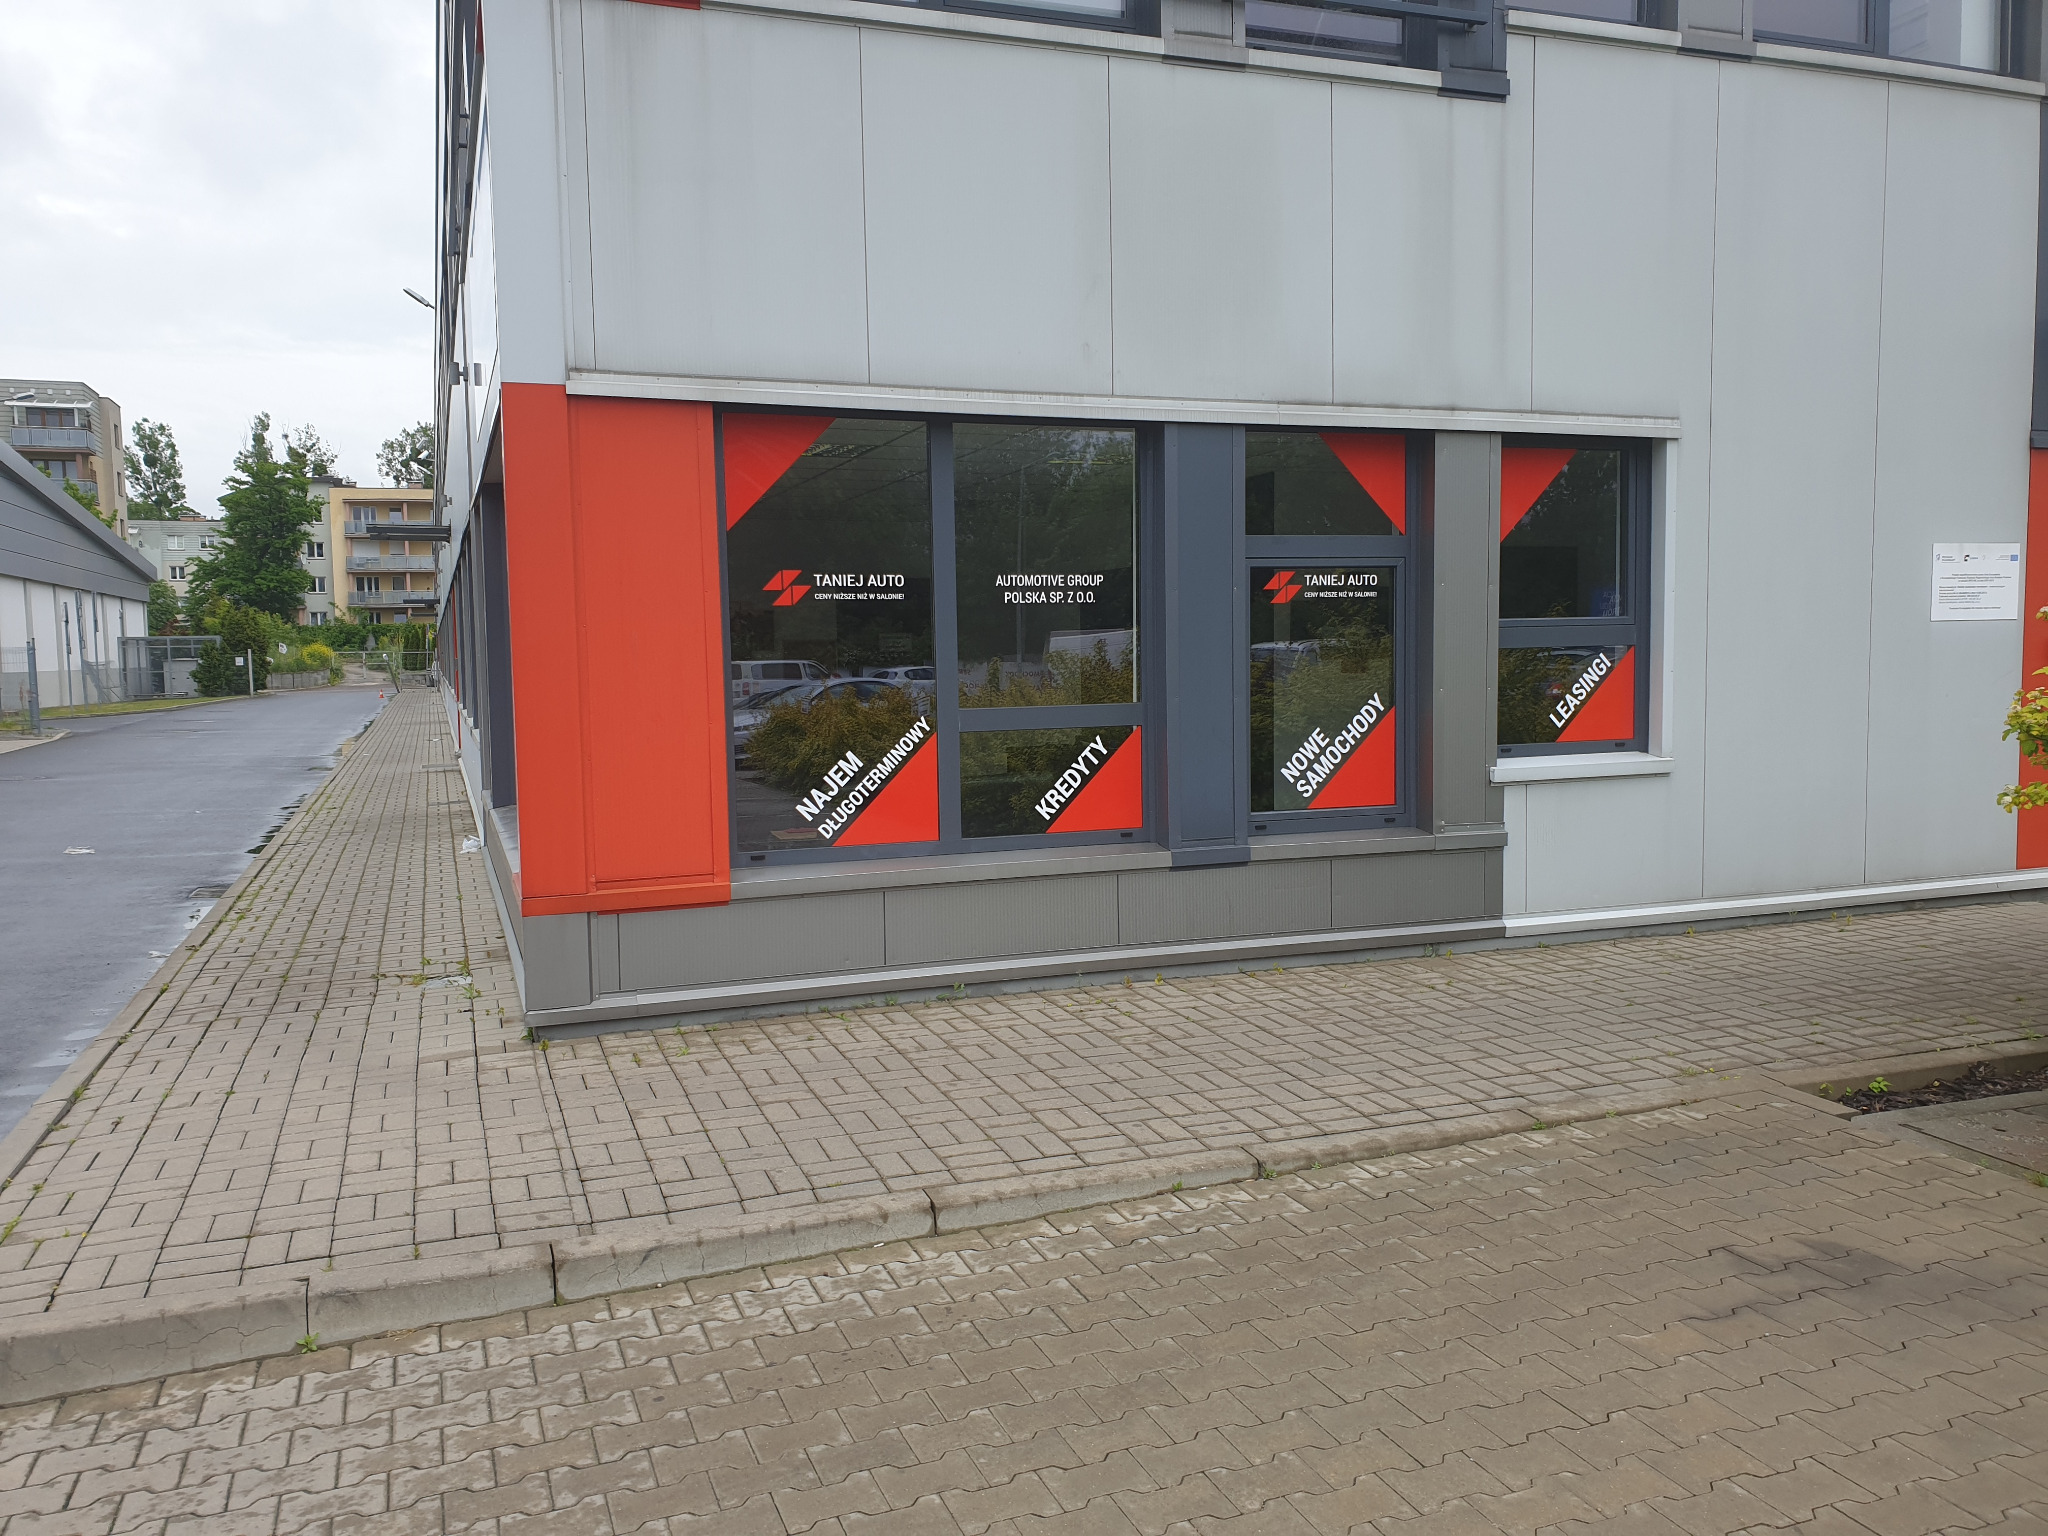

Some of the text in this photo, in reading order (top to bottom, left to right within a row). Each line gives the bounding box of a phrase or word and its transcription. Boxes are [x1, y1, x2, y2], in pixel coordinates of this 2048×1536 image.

[813, 573, 905, 587] TANIEJ AUTO
[995, 574, 1104, 587] AUTOMOTIVE GROUP
[1004, 591, 1096, 604] POLSKA SP. Z O.O.
[1304, 574, 1378, 586] TANIEJ AUTO
[1548, 652, 1612, 729] LEASINGI
[1280, 727, 1330, 784] NOWE
[1296, 692, 1385, 798] SAMOCHODY
[795, 750, 864, 822] NAJEM
[817, 715, 931, 840] DŁUGOTERMINOWY
[1034, 734, 1108, 821] KREDYTY
